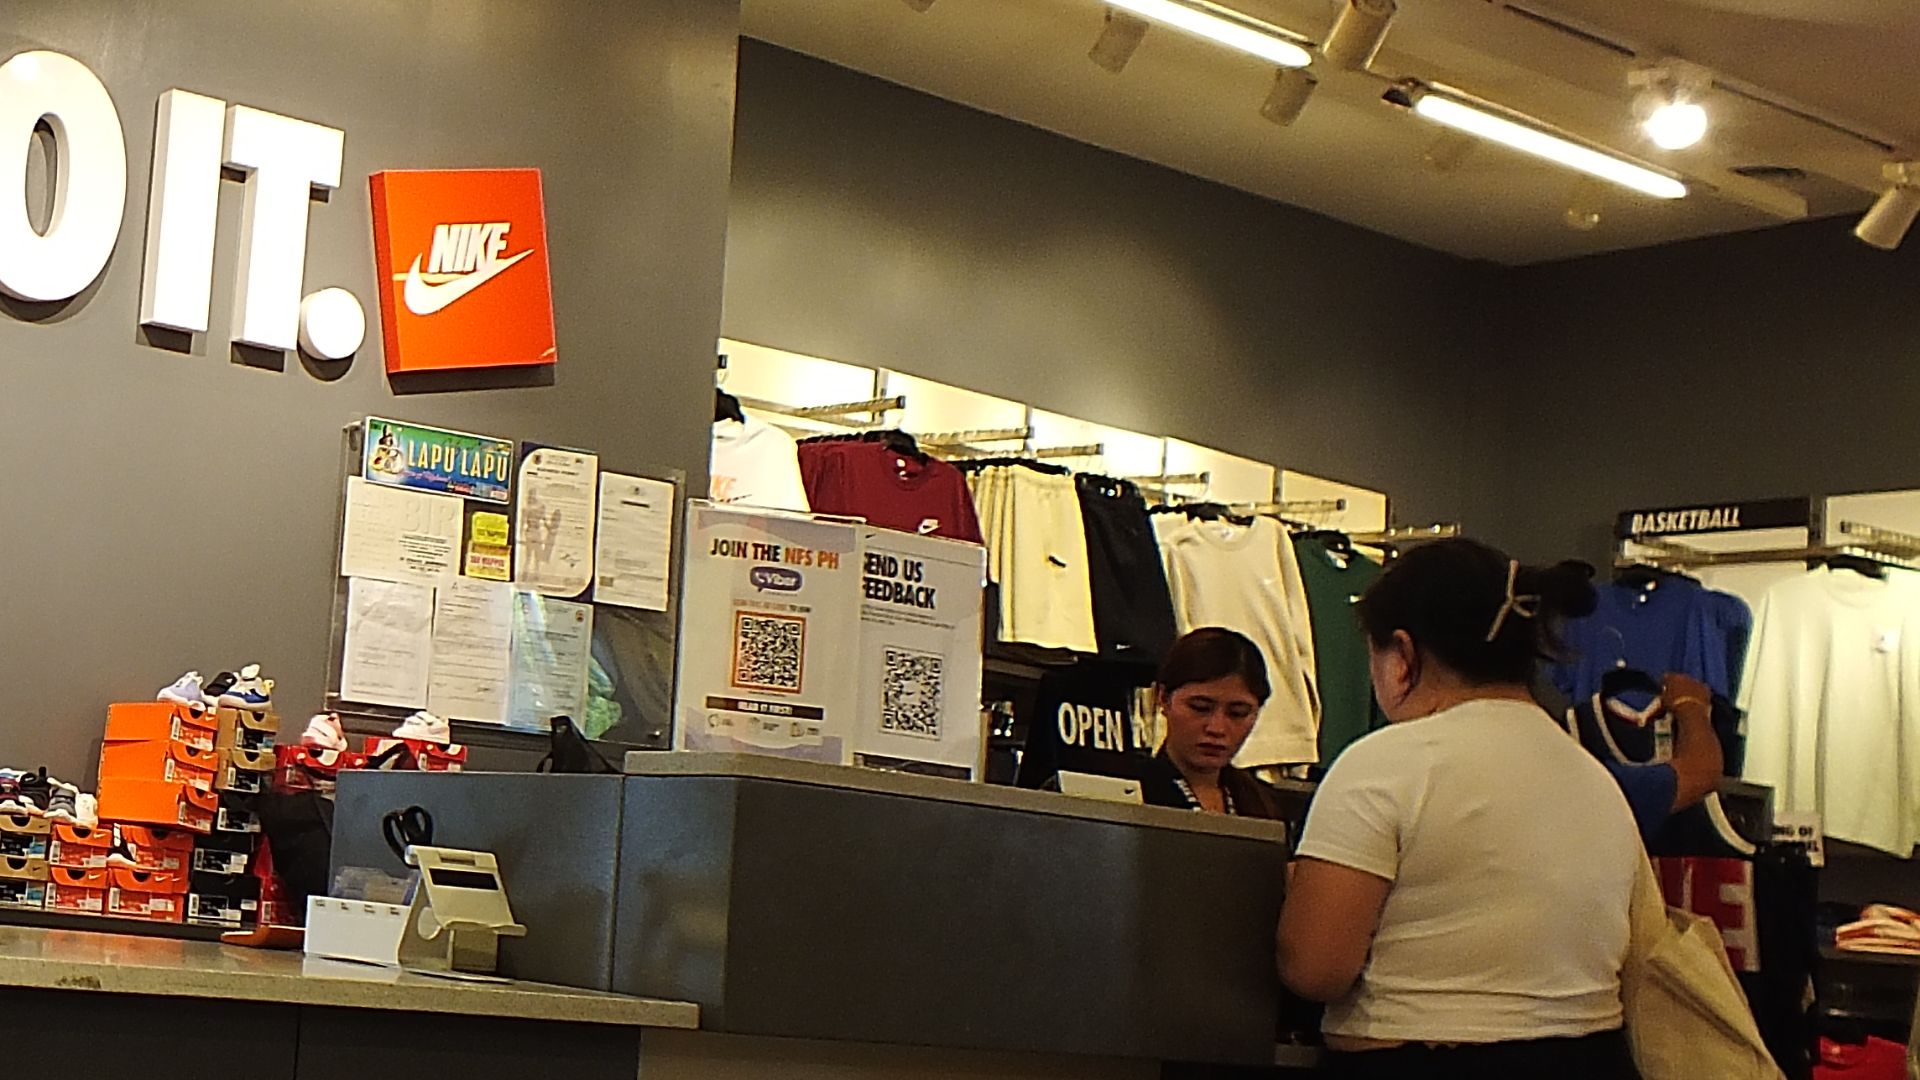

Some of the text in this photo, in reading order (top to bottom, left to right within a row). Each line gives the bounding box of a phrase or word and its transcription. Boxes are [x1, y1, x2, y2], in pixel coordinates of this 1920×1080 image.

[140, 88, 366, 360] IT.
[428, 222, 511, 273] NIKE
[408, 440, 507, 481] LAPU LAPU
[1632, 507, 1740, 533] BASKETBALL
[710, 539, 839, 569] JOIN THE NFS PH
[903, 558, 923, 583] US
[1058, 701, 1124, 752] OPEN
